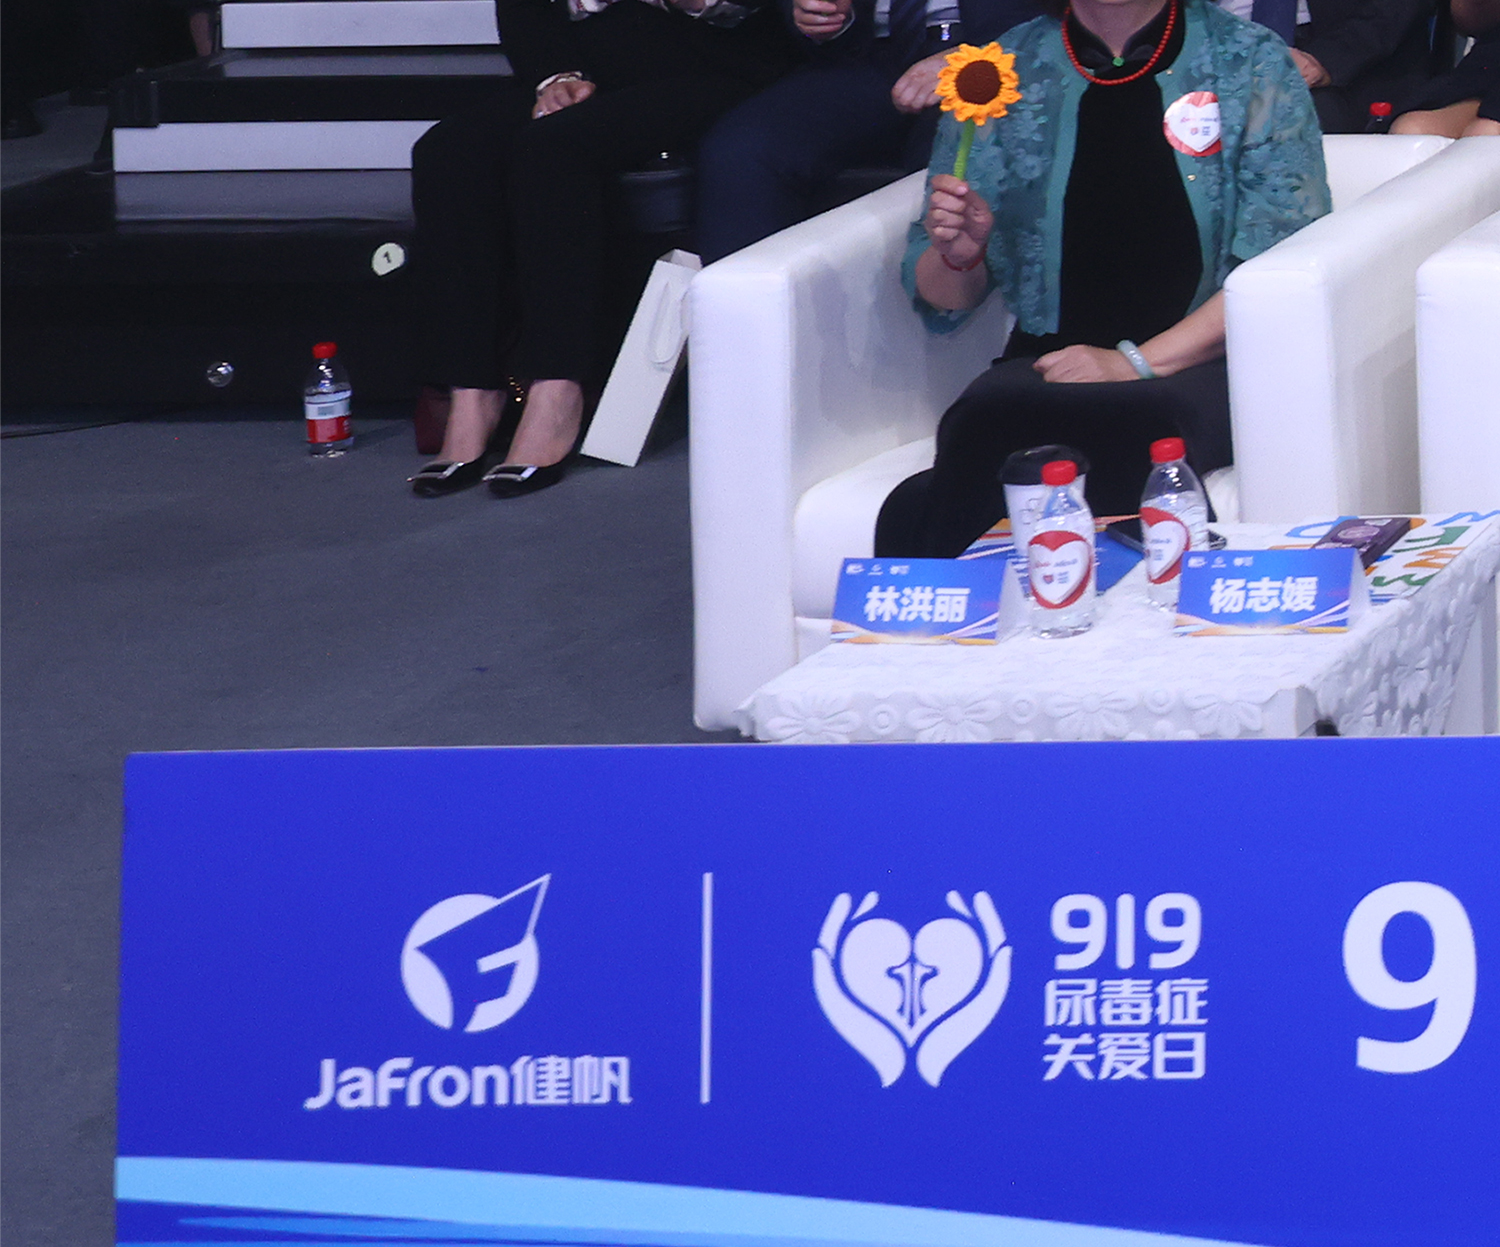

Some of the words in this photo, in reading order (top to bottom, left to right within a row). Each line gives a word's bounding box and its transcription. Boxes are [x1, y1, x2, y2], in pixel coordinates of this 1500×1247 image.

[383, 251, 392, 264] 1
[864, 585, 971, 623] 林洪丽
[1209, 575, 1319, 614] 杨志媛
[1051, 892, 1202, 971] 919
[1044, 977, 1209, 1027] 尿毒症
[1043, 1032, 1206, 1081] 关爱日
